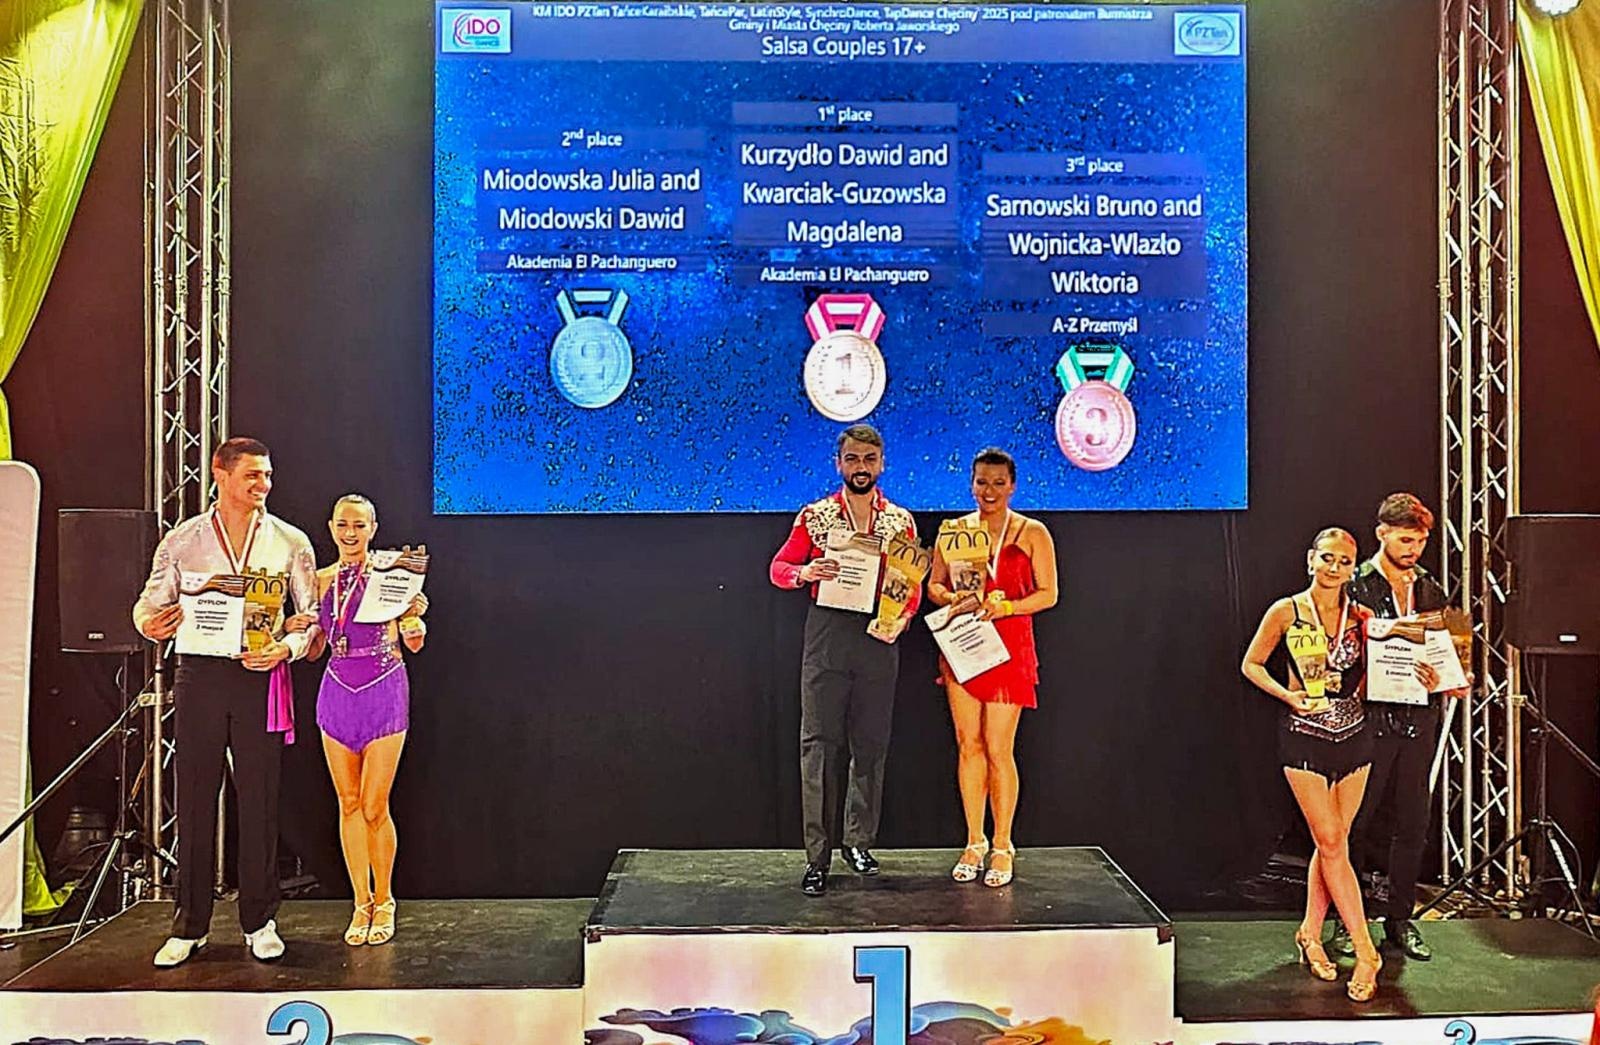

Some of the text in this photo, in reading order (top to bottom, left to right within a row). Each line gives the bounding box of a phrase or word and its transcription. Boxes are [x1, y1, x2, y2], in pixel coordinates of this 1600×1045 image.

[554, 5, 575, 17] IDO
[982, 8, 1009, 19] 2025
[1011, 8, 1033, 22] pod
[467, 18, 501, 35] IDO
[729, 19, 764, 33] Gminy
[766, 20, 770, 31] i
[772, 20, 808, 31] Miasta
[853, 20, 893, 32] Roberta
[762, 36, 926, 60] Salsa Couples 17+
[817, 105, 873, 124] 1st place
[562, 128, 623, 149] 2nd place
[741, 143, 949, 172] Kurzydło Dawid and
[1066, 156, 1124, 175] 3rd place
[483, 168, 701, 191] Miodowska Julia and
[743, 181, 947, 205] Kwarciak-Guzowska
[986, 194, 1203, 217] Sarnowski Bruno and
[499, 207, 685, 230] Miodowski Dawid
[787, 219, 904, 248] Magdalena
[1008, 232, 1182, 261] Wojnicka-Wlazło
[506, 254, 678, 272] Akademia El Pachanguero
[760, 267, 930, 285] Akademia El Pachanguero
[1051, 271, 1139, 294] Wiktoria
[1052, 317, 1138, 337] A-Z Przemyśl
[940, 530, 990, 551] 700
[892, 537, 931, 572] 700
[243, 577, 285, 595] 700
[1289, 634, 1327, 648] 700
[853, 944, 912, 1045] 1
